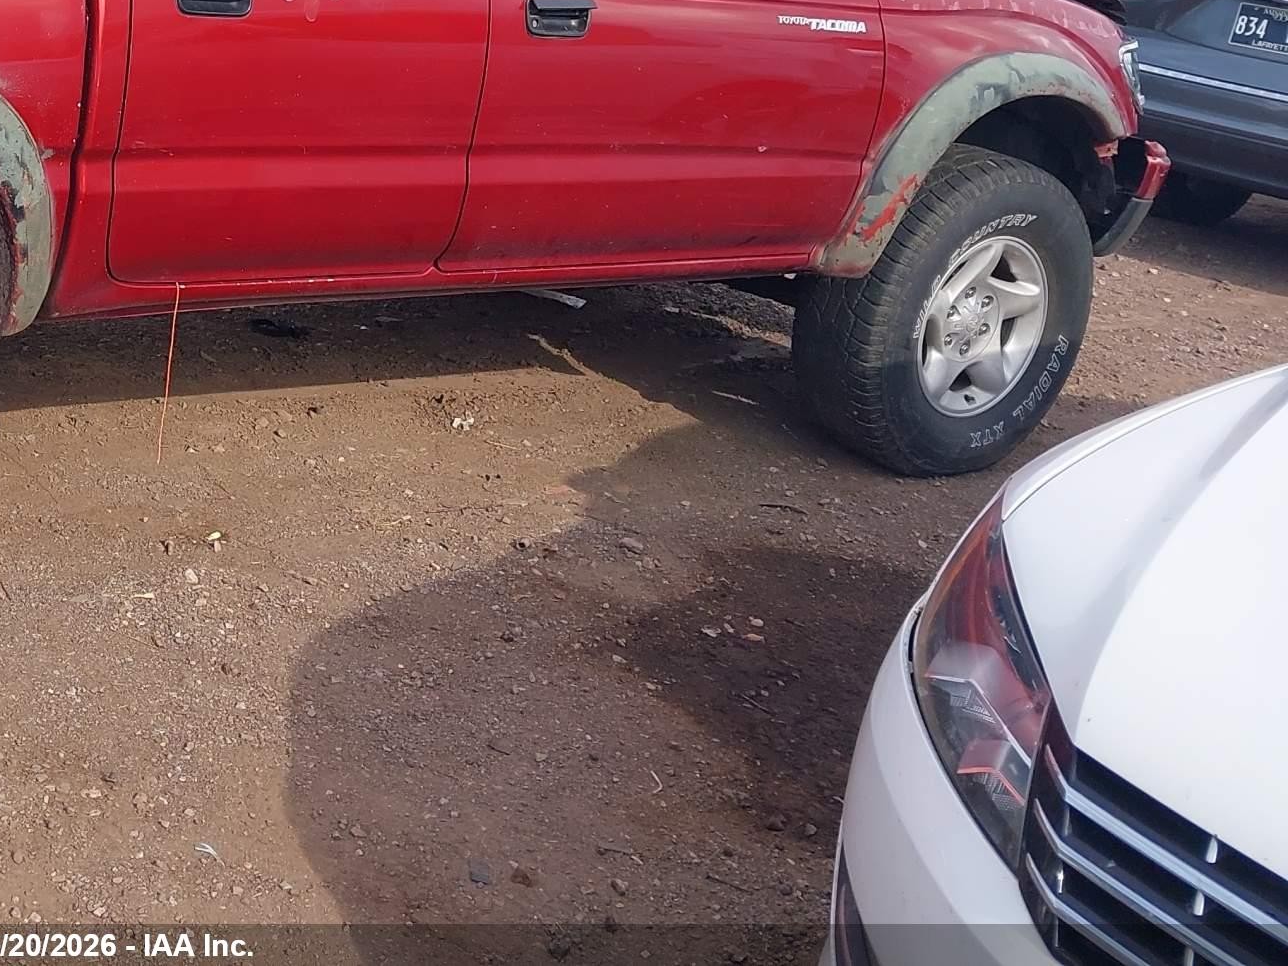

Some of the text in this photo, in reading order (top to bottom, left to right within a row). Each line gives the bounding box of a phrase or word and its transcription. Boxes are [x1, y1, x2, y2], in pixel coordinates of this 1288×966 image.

[777, 15, 867, 33] TOYOTA TACOMA
[1235, 15, 1269, 39] 834
[970, 334, 1070, 448] RADIAL XTX
